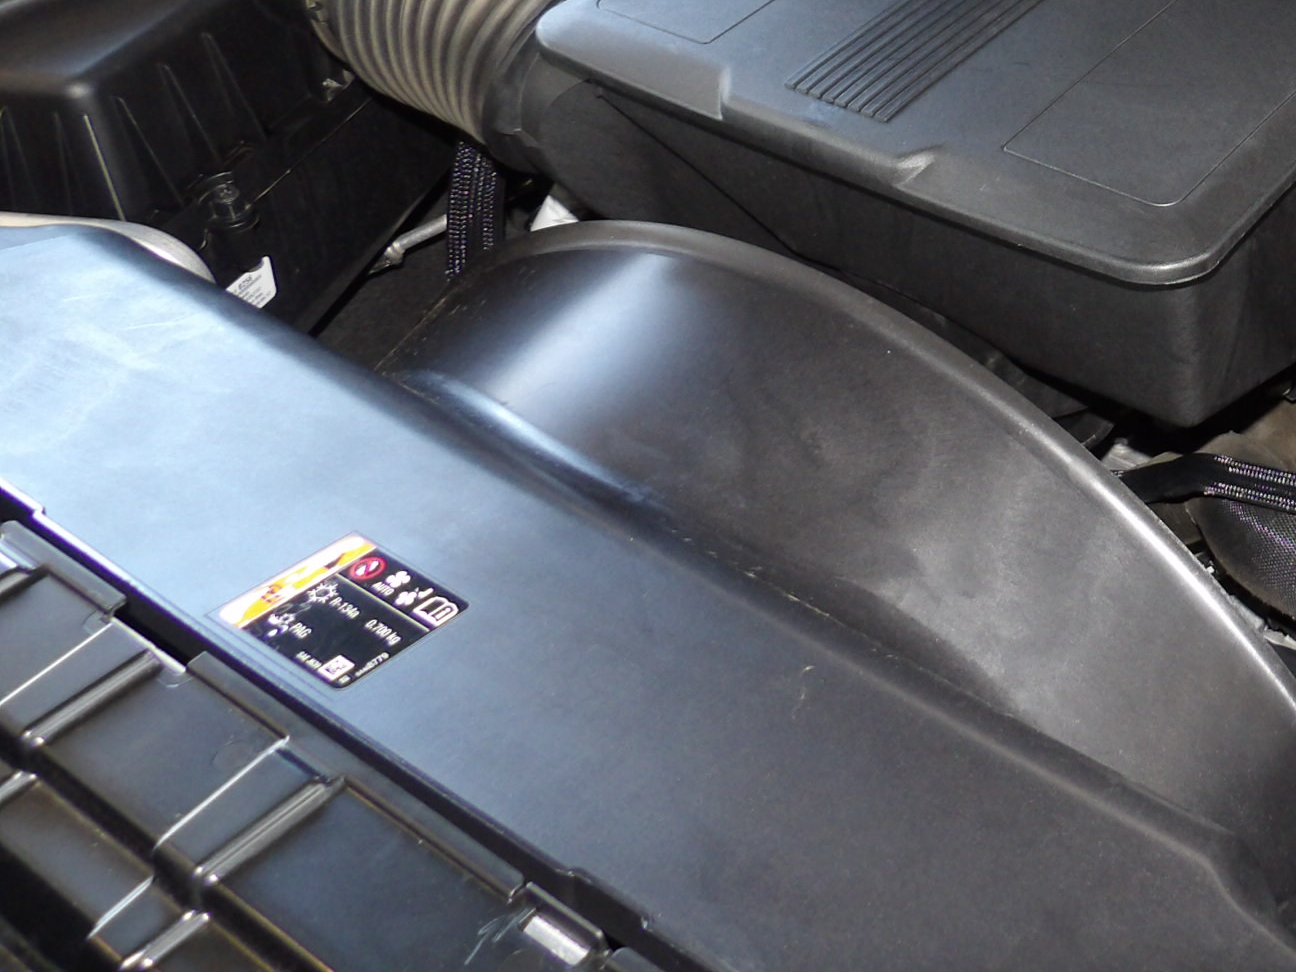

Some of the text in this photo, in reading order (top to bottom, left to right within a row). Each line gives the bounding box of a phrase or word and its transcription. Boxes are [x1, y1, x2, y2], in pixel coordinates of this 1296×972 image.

[371, 581, 396, 597] AUTO
[328, 596, 402, 647] R-134a 0.700 kg
[289, 622, 312, 639] PAG
